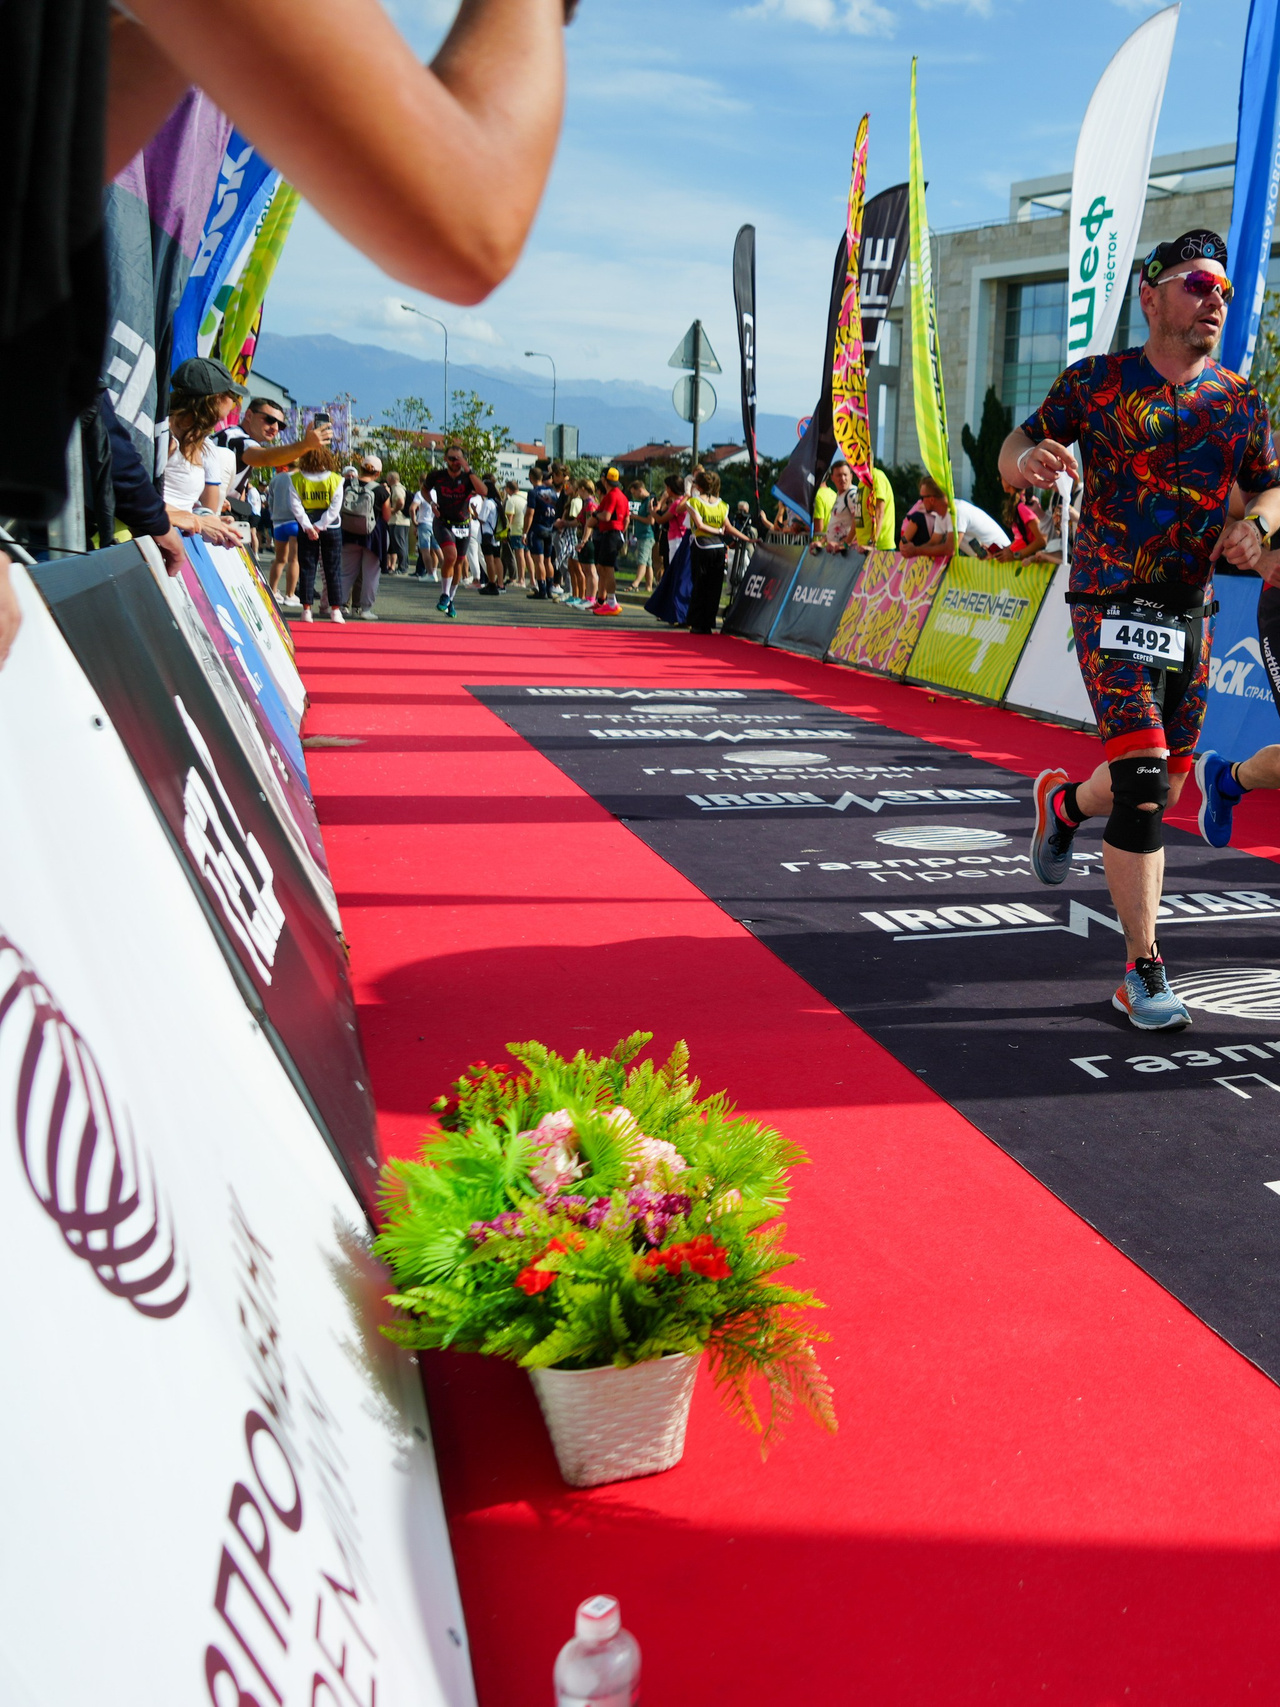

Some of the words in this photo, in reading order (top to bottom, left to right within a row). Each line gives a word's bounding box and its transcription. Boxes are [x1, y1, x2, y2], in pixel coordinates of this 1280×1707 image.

[942, 587, 1030, 621] FAHRENHEIT
[1115, 624, 1171, 654] 4492
[1132, 652, 1154, 664] СЕРГЕЙ
[588, 729, 699, 738] IRON
[742, 728, 852, 739] STAR
[685, 791, 828, 807] IRON
[877, 788, 1016, 802] STAR
[860, 901, 1056, 933] IRON
